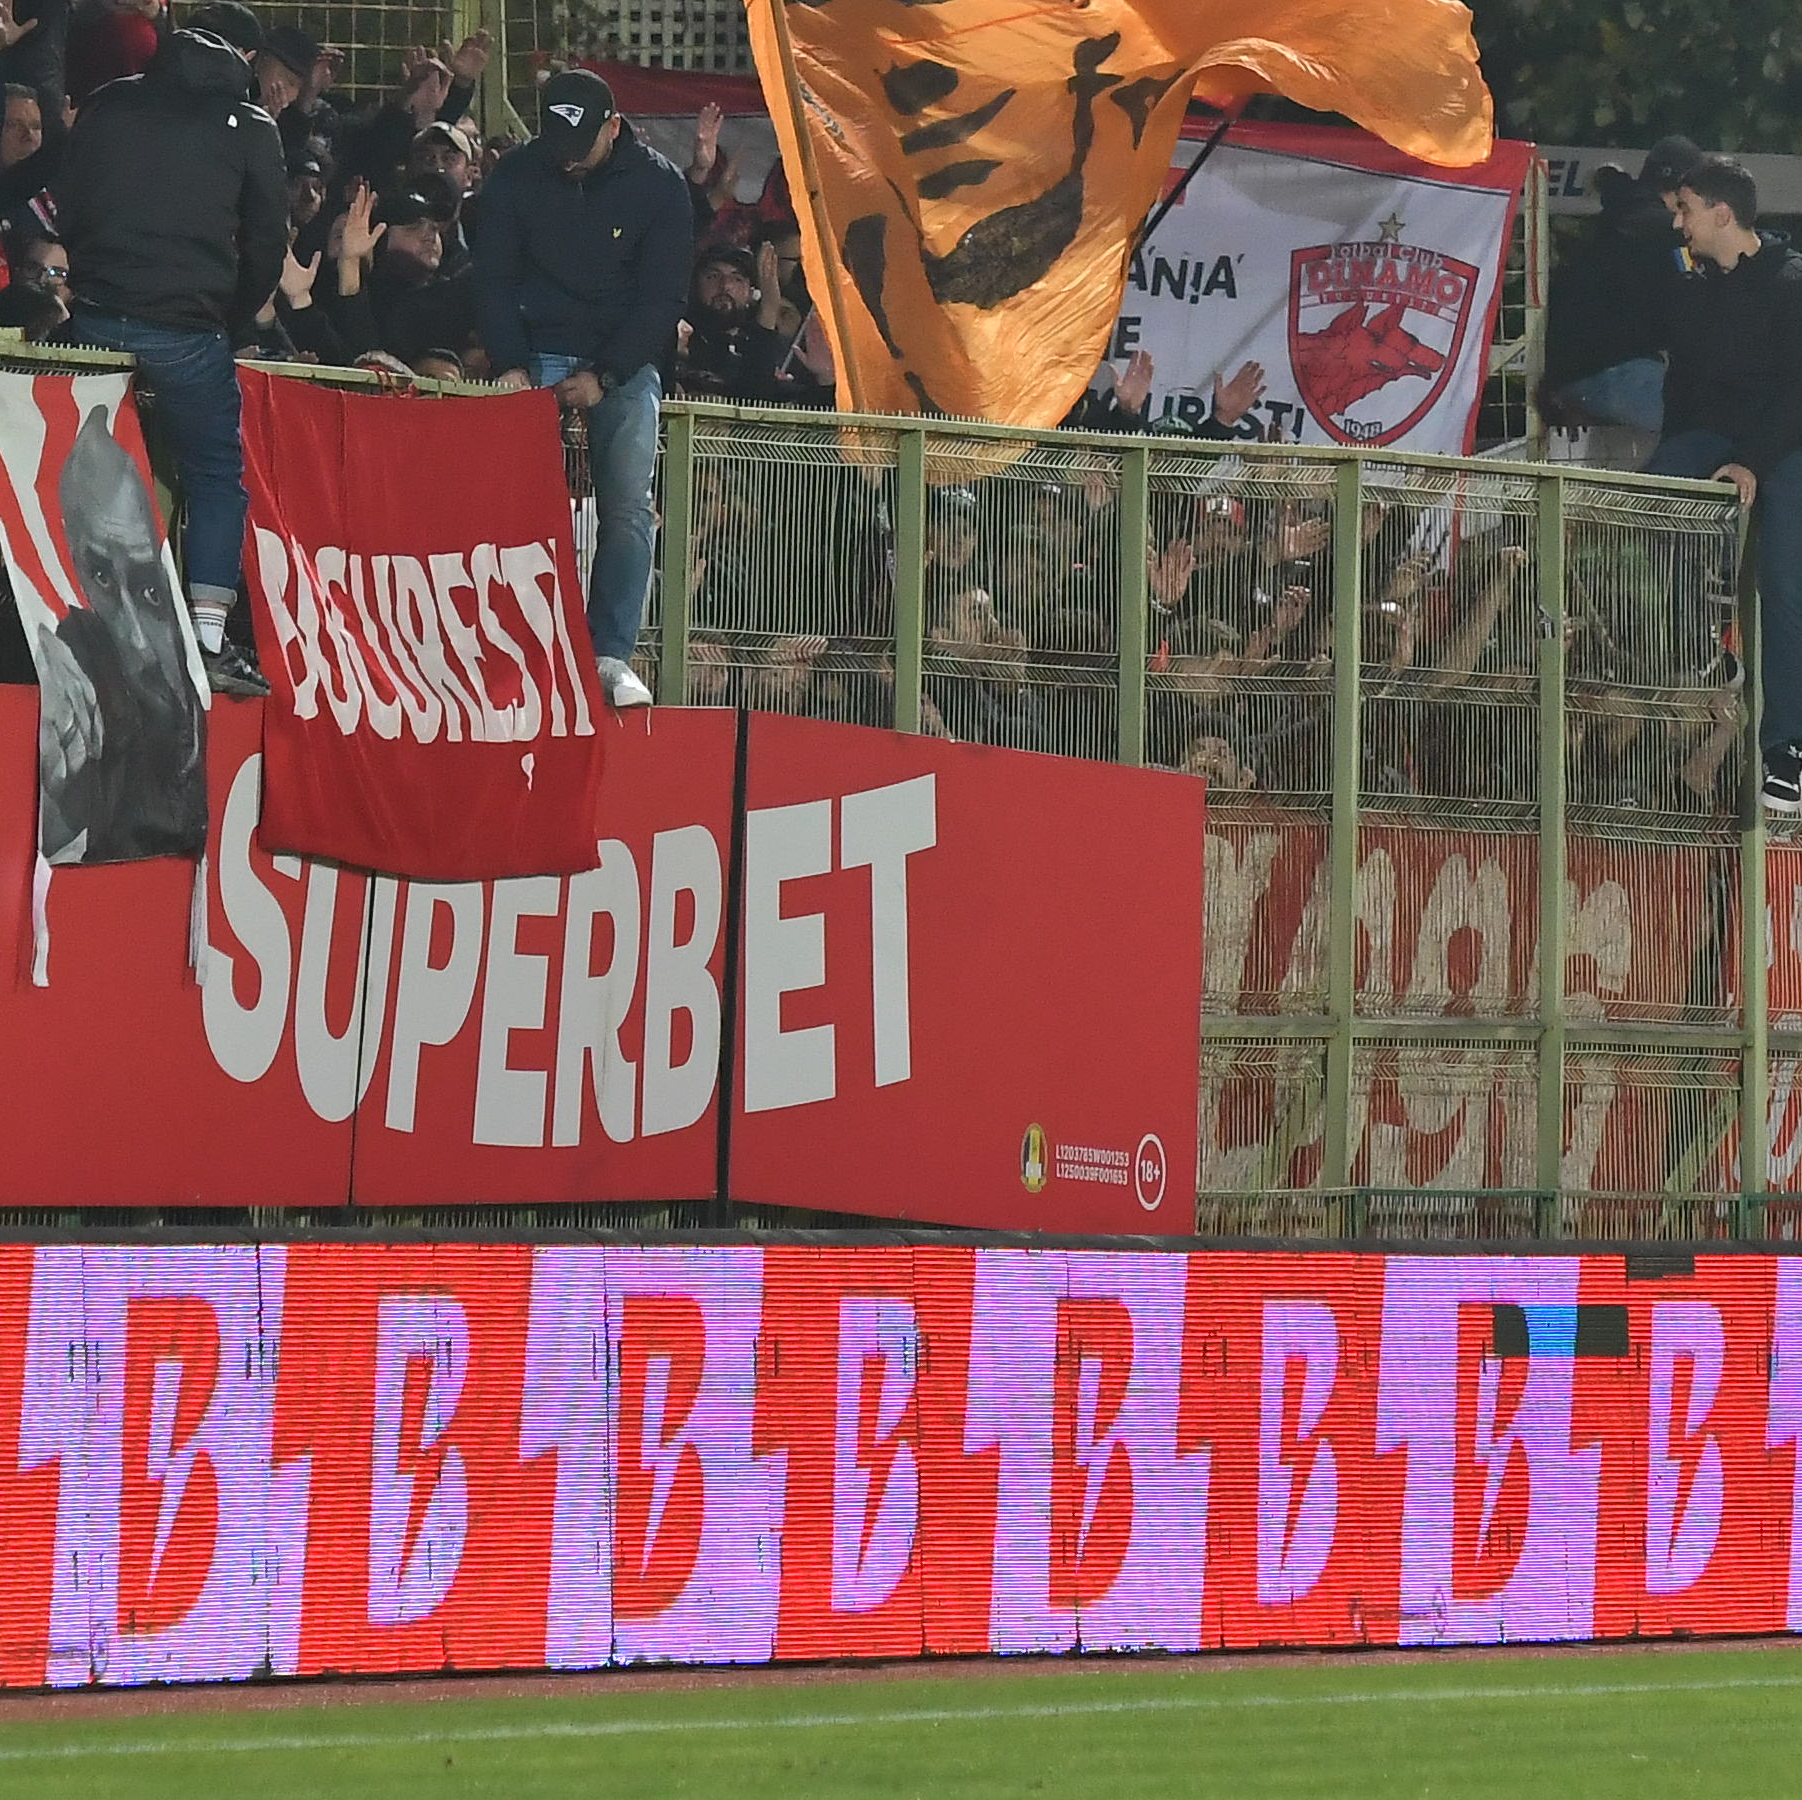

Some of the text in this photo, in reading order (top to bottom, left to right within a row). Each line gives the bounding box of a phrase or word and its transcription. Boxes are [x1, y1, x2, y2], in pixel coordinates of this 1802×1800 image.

[1140, 1159, 1161, 1183] 18+
[117, 1296, 221, 1635] B
[367, 1295, 470, 1626] B
[613, 1296, 706, 1619] B
[831, 1297, 918, 1612] B
[1048, 1298, 1134, 1608] B
[1257, 1300, 1340, 1604] B
[1452, 1302, 1530, 1599] B
[1645, 1301, 1727, 1594] B
